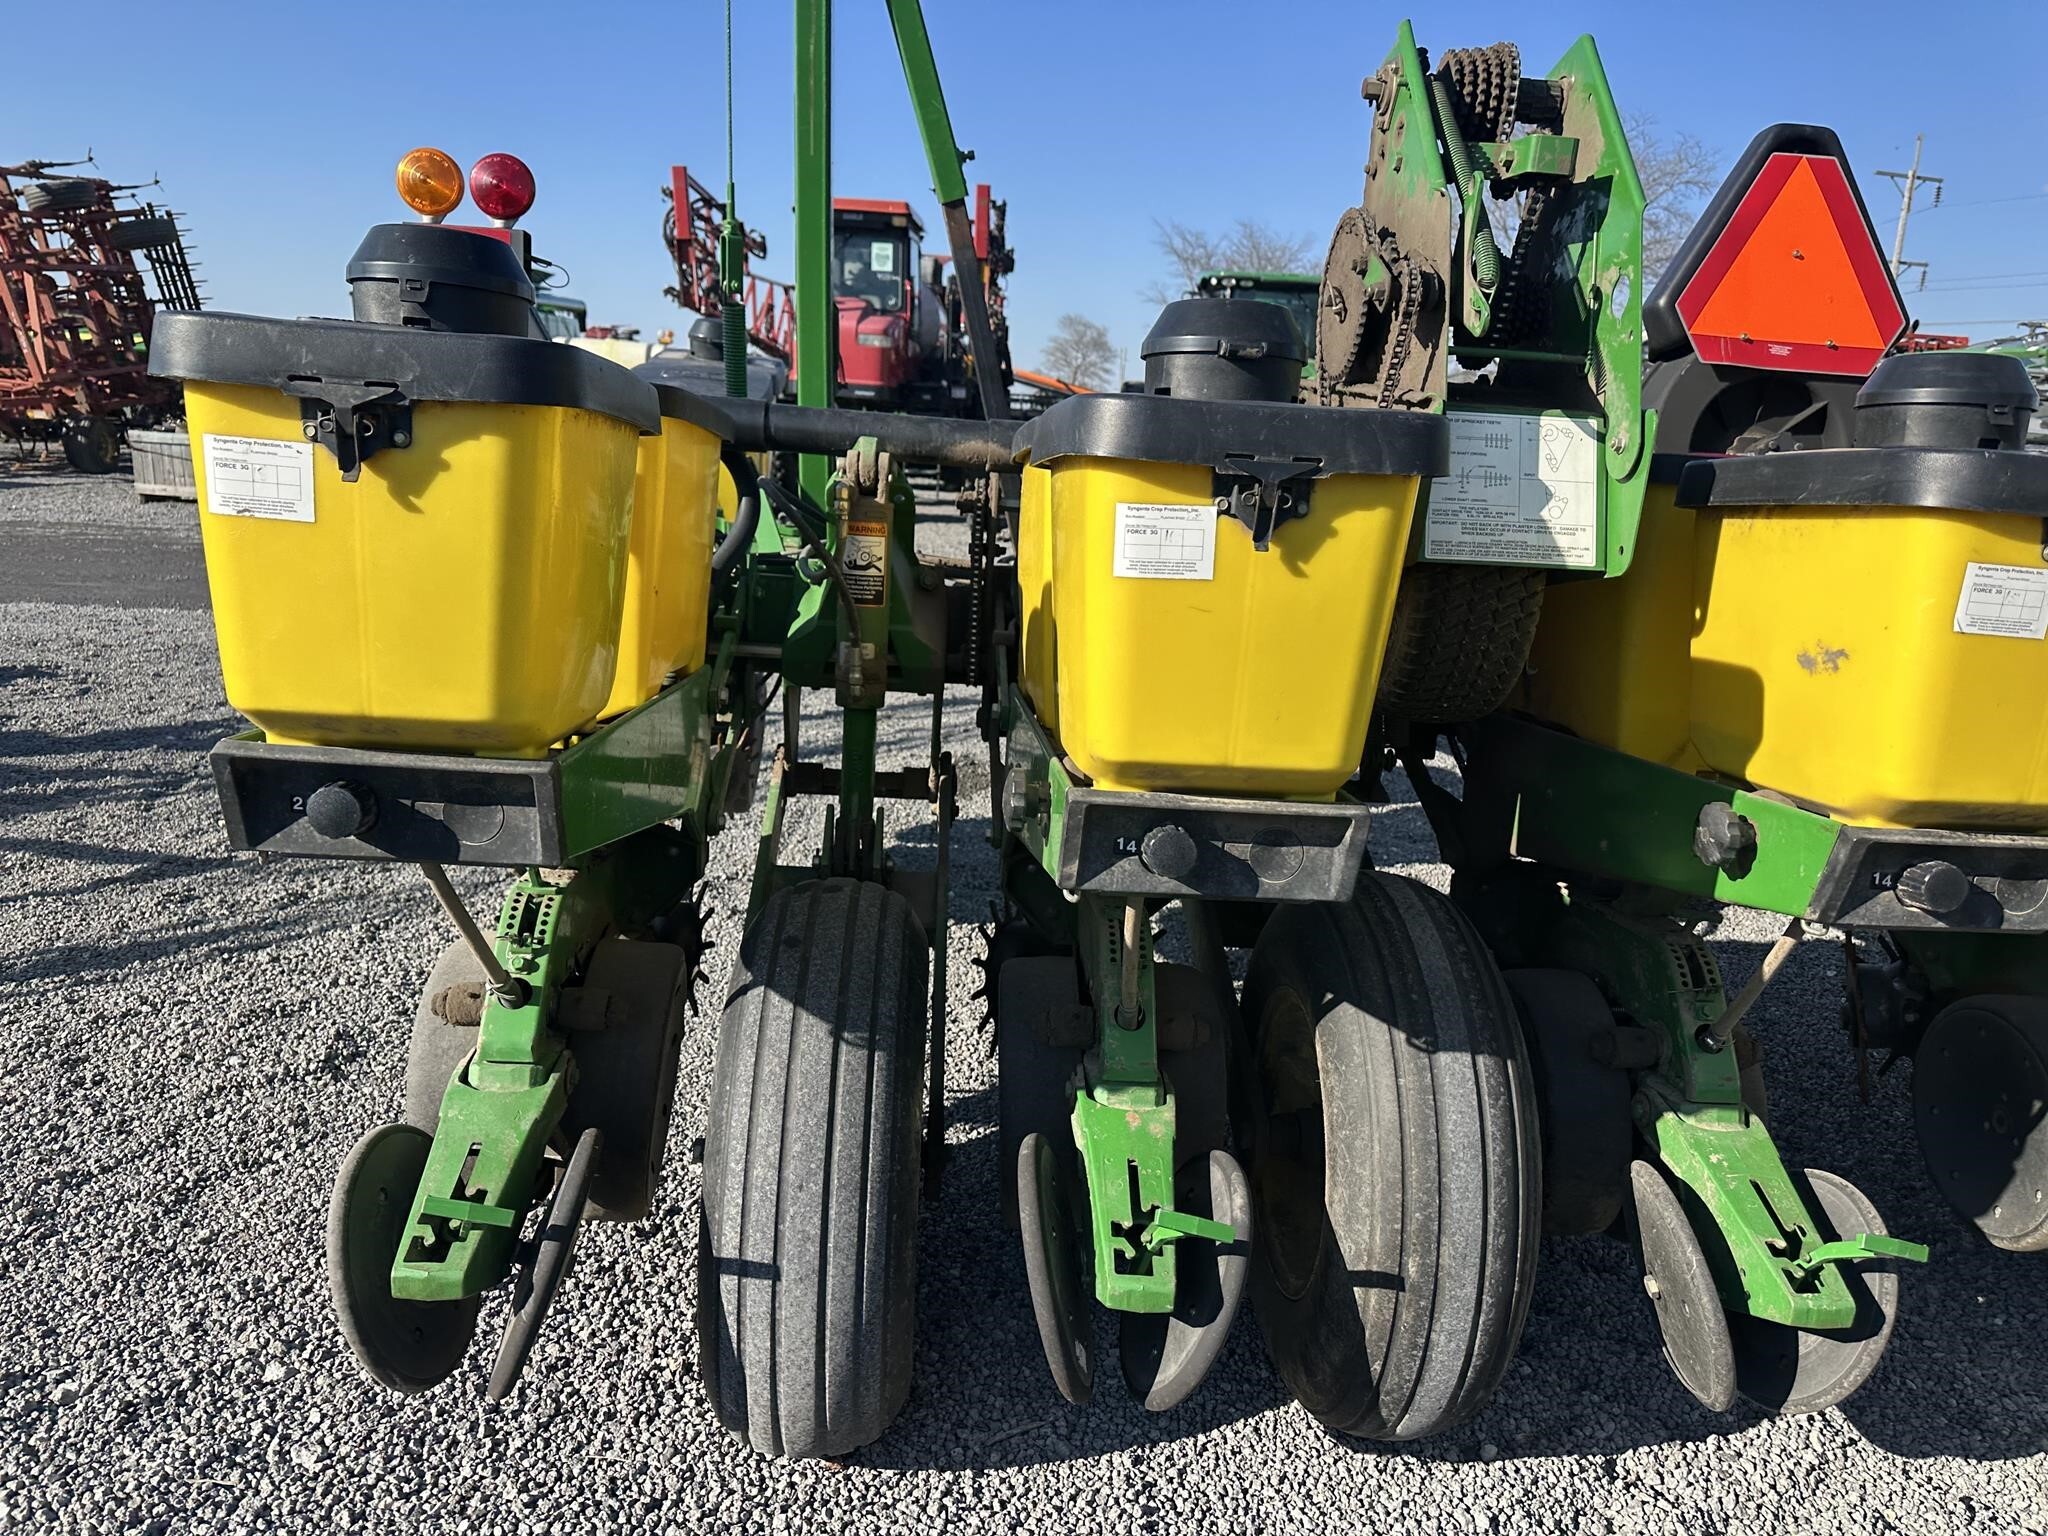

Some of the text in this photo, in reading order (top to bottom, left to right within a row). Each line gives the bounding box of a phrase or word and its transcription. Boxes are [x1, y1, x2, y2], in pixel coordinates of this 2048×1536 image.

[213, 437, 238, 445] Syngenta
[215, 461, 237, 469] FORCE
[848, 525, 886, 534] WARNING
[292, 796, 304, 810] 2
[1116, 837, 1137, 853] 14
[1873, 871, 1892, 887] 14
